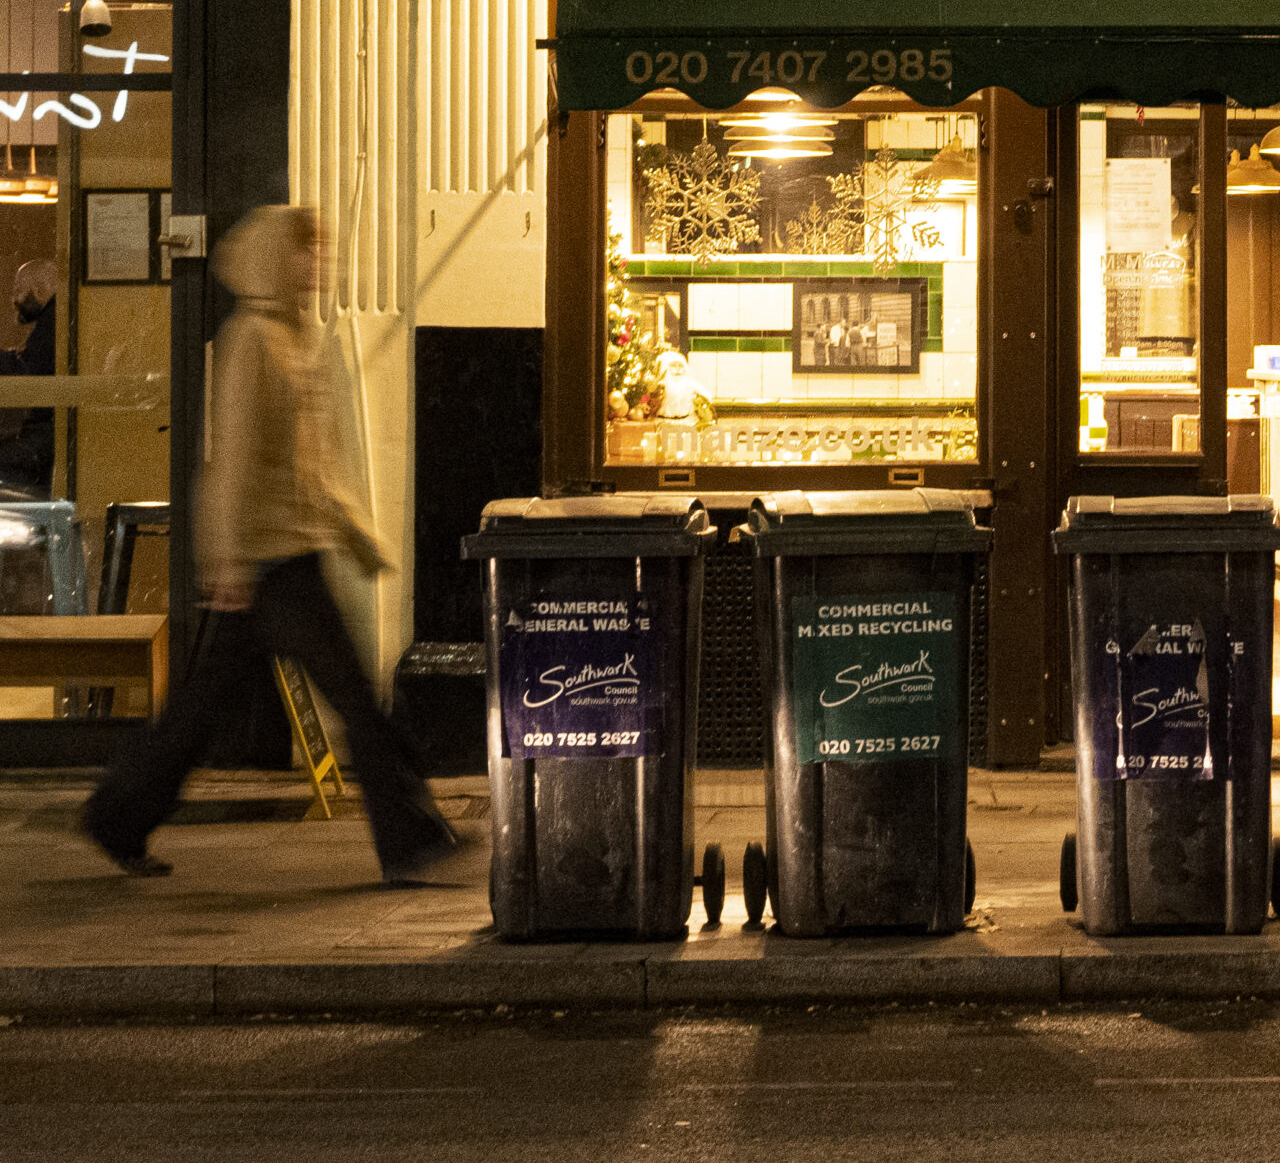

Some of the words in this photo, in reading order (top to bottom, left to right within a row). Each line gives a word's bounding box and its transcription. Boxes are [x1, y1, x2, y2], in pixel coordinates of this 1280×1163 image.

[625, 51, 709, 84] 020
[726, 50, 828, 84] 7407
[845, 48, 953, 83] 2985
[657, 416, 937, 454] manze.co.uk
[818, 602, 932, 619] COMMERCIAL
[798, 624, 854, 638] MXED
[858, 619, 953, 636] RECYCLING
[523, 652, 637, 708] Southwark
[819, 649, 933, 708] Southwark
[901, 682, 933, 692] Council
[604, 685, 638, 695] Council
[523, 733, 554, 747] 020
[557, 733, 597, 747] 7525
[600, 732, 640, 746] 2627
[818, 740, 851, 755] 020
[855, 738, 896, 754] 7525
[900, 736, 941, 752] 2627
[1150, 755, 1189, 769] 7525
